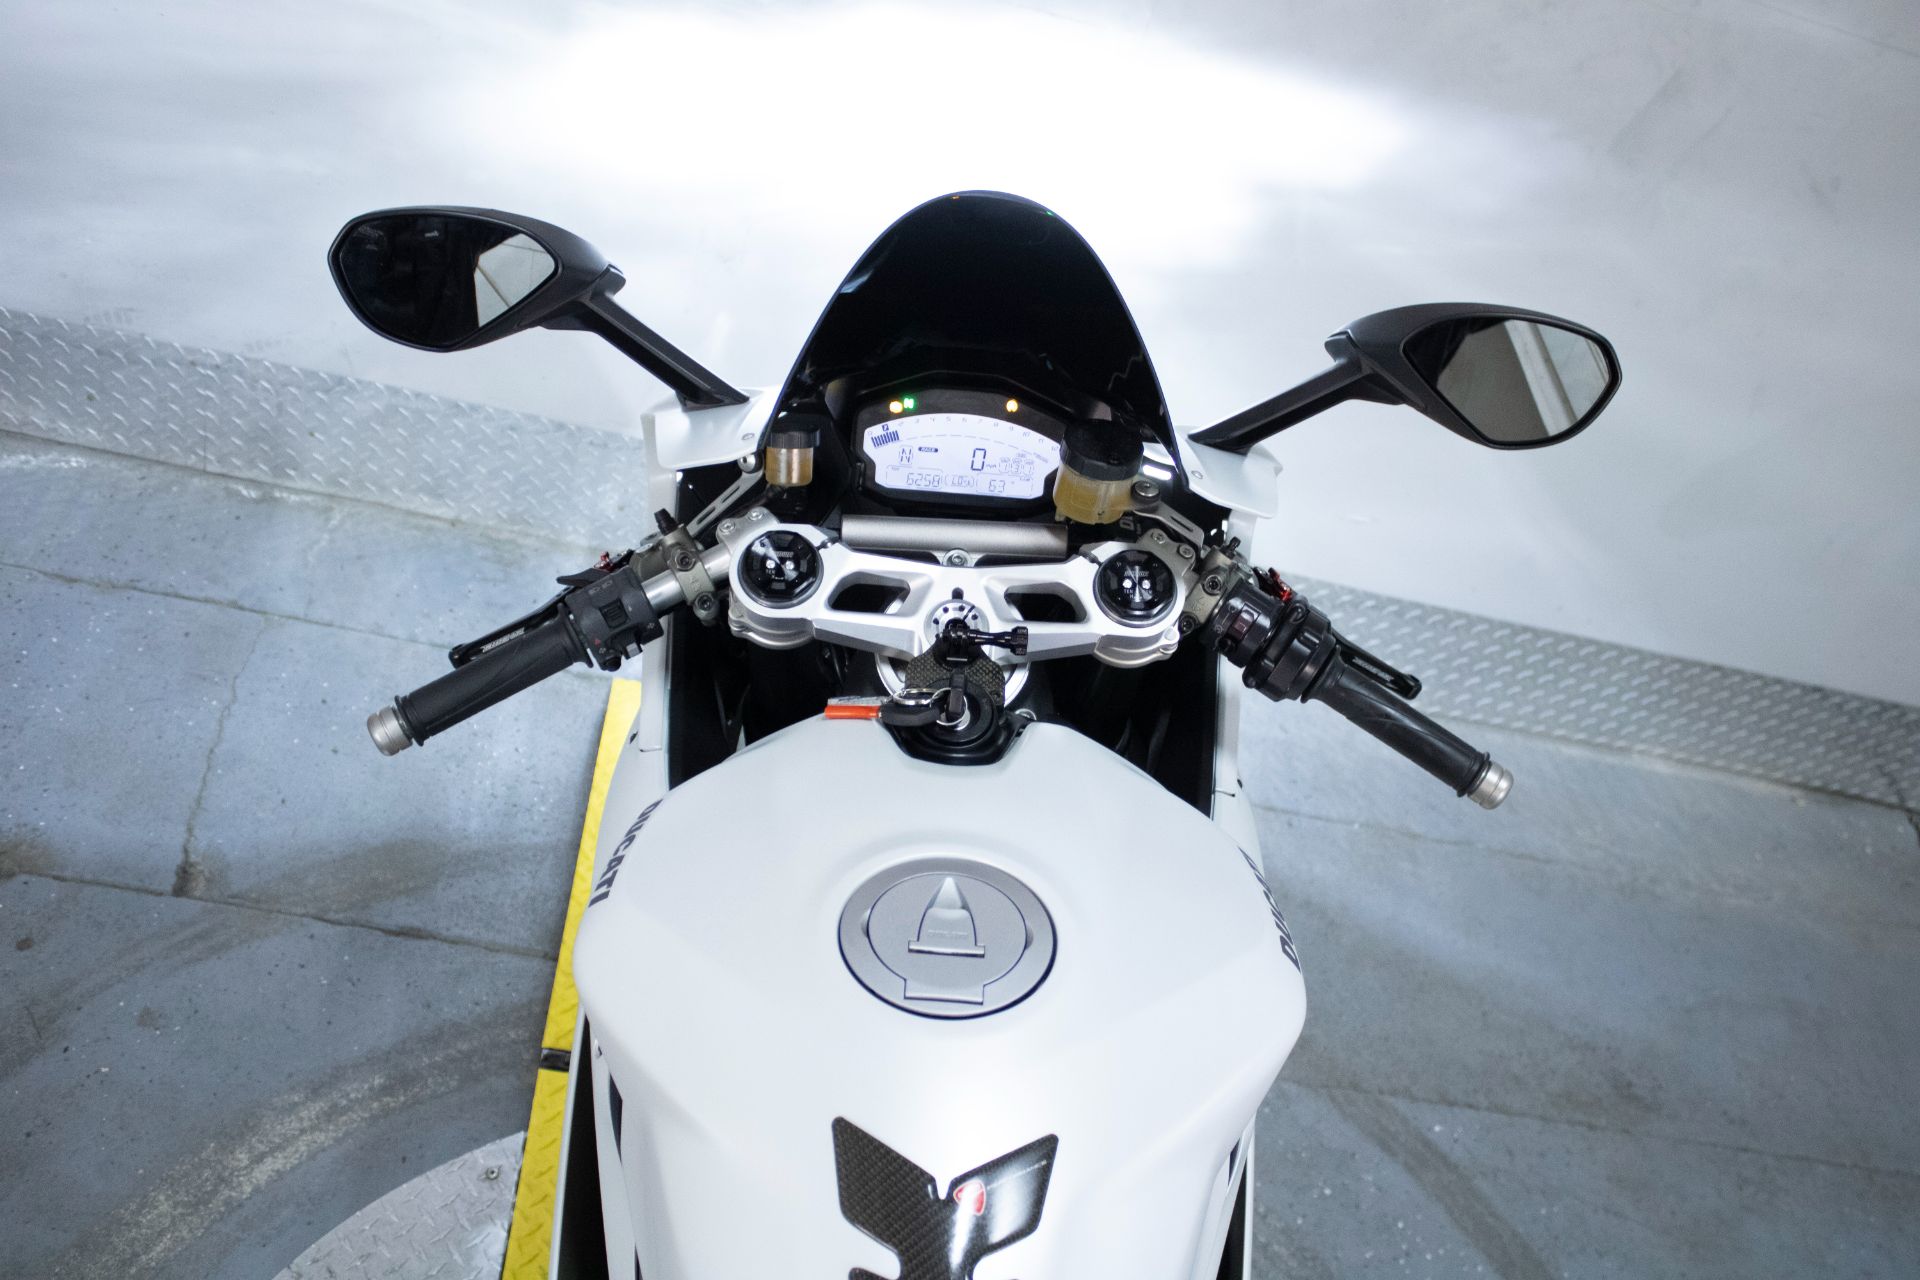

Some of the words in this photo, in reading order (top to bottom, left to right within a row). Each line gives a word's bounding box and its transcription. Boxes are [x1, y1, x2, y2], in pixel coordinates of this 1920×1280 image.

[970, 447, 987, 472] 0
[906, 472, 941, 488] 6258
[988, 479, 1006, 493] 63
[588, 798, 664, 908] DUCATI
